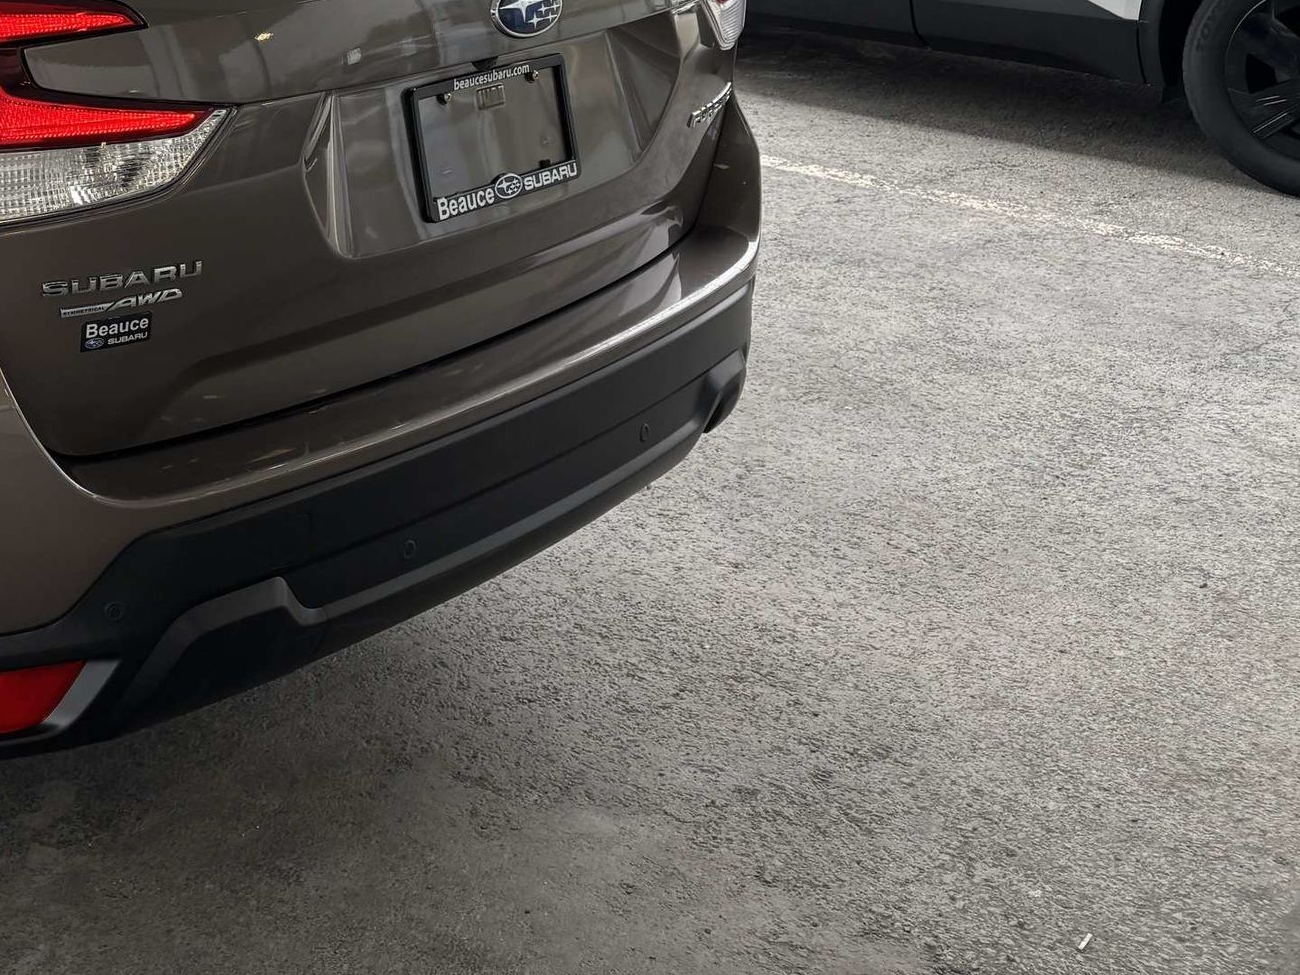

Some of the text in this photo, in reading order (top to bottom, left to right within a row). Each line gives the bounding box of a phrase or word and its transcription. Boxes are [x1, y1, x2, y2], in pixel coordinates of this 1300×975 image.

[453, 64, 530, 91] beaucesubaru.com
[436, 162, 578, 221] Beauce SUBARU
[42, 260, 203, 297] SUBARU
[105, 287, 184, 312] AWD
[85, 317, 150, 339] Beauce
[107, 331, 149, 345] SUBARU
